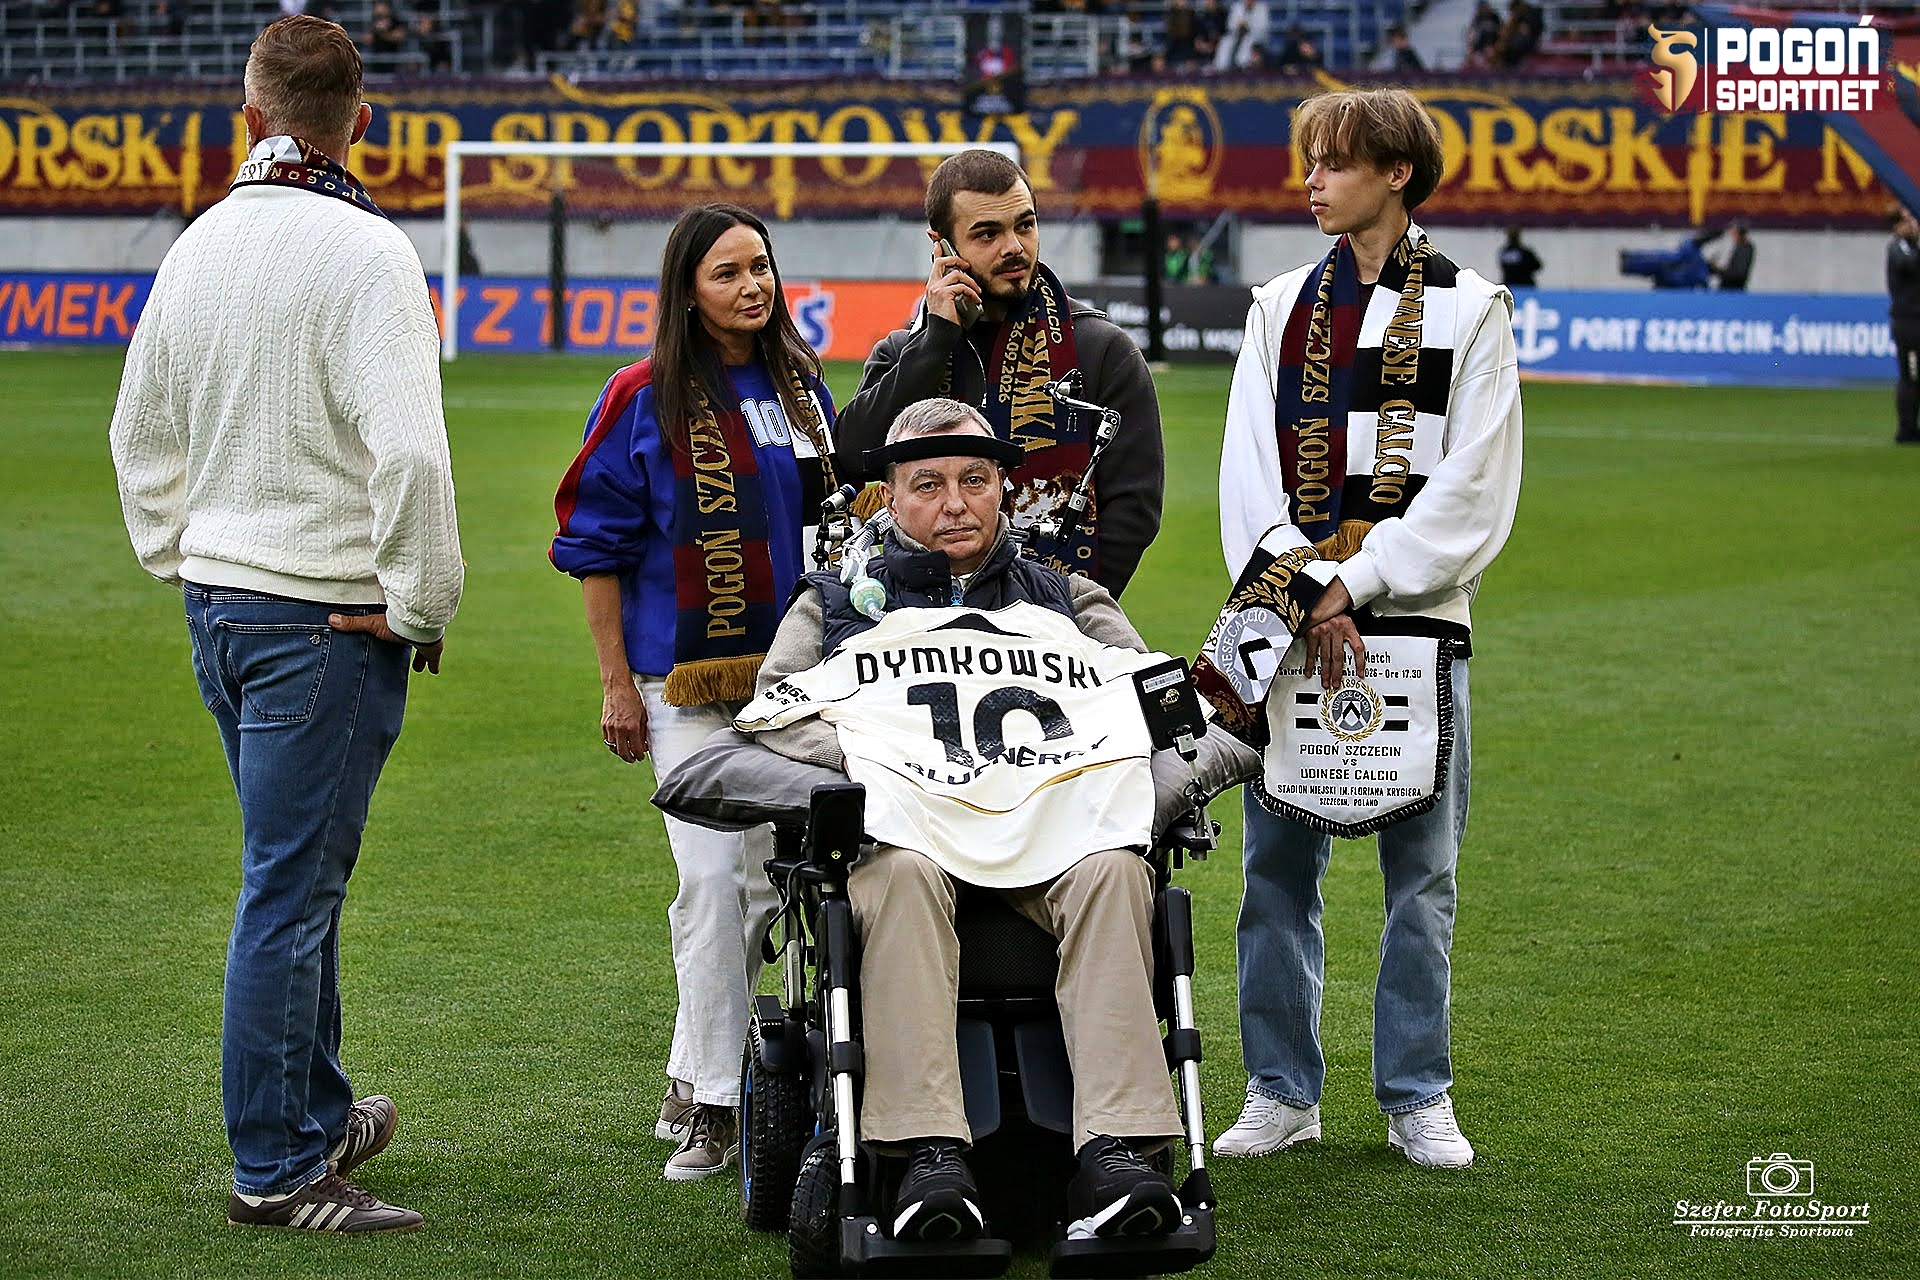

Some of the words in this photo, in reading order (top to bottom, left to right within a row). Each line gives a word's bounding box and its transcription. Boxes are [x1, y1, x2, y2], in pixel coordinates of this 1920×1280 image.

[0, 110, 202, 216] RSKI
[489, 105, 1078, 220] SPORTOWY
[0, 282, 136, 337] MEK
[472, 287, 520, 343] Z
[532, 287, 658, 346] TOB
[1569, 317, 1640, 351] PORT
[998, 321, 1025, 404] 26.09.2026
[740, 398, 793, 449] 10
[1291, 417, 1330, 524] POGOŃ
[1368, 399, 1417, 505] CALCIO
[695, 528, 746, 640] POGOŃ
[855, 646, 1103, 689] DYMKOWSKI
[1341, 679, 1361, 690] 1896
[1364, 668, 1378, 678] 026
[1385, 670, 1399, 679] Ore
[1402, 669, 1422, 679] 17.30
[907, 681, 1075, 769] 10
[1299, 740, 1339, 756] POGOŃ
[1345, 745, 1401, 757] SZCZECIN
[1277, 784, 1308, 794] STADION
[1310, 785, 1337, 796] MIEJSKI
[1350, 786, 1385, 797] FLORIANA
[1386, 787, 1422, 797] KRYGIERA
[1300, 768, 1350, 780] UDINESE
[1354, 769, 1398, 782] CALCIO
[1353, 798, 1379, 807] POLAND
